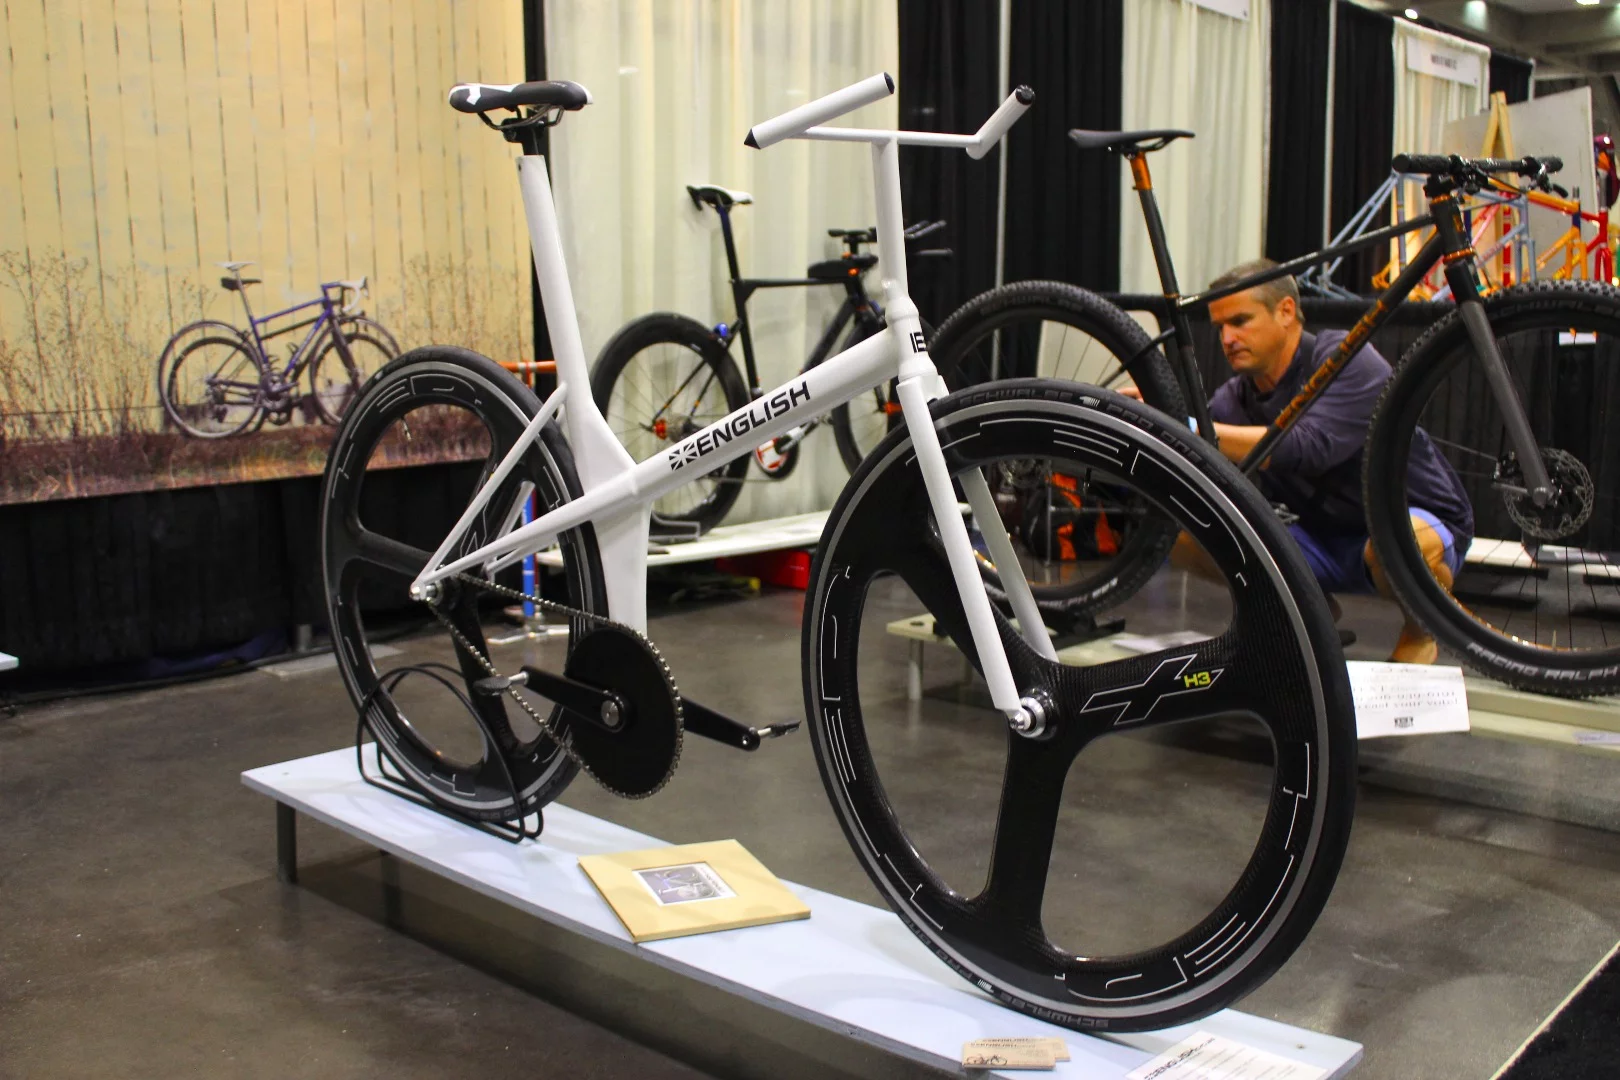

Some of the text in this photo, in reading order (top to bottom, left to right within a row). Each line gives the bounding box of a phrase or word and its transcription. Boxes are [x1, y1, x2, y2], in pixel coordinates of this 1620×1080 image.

[697, 380, 811, 457] ENGLISH
[1183, 671, 1212, 688] H3
[1466, 641, 1619, 681] RACING RALPH
